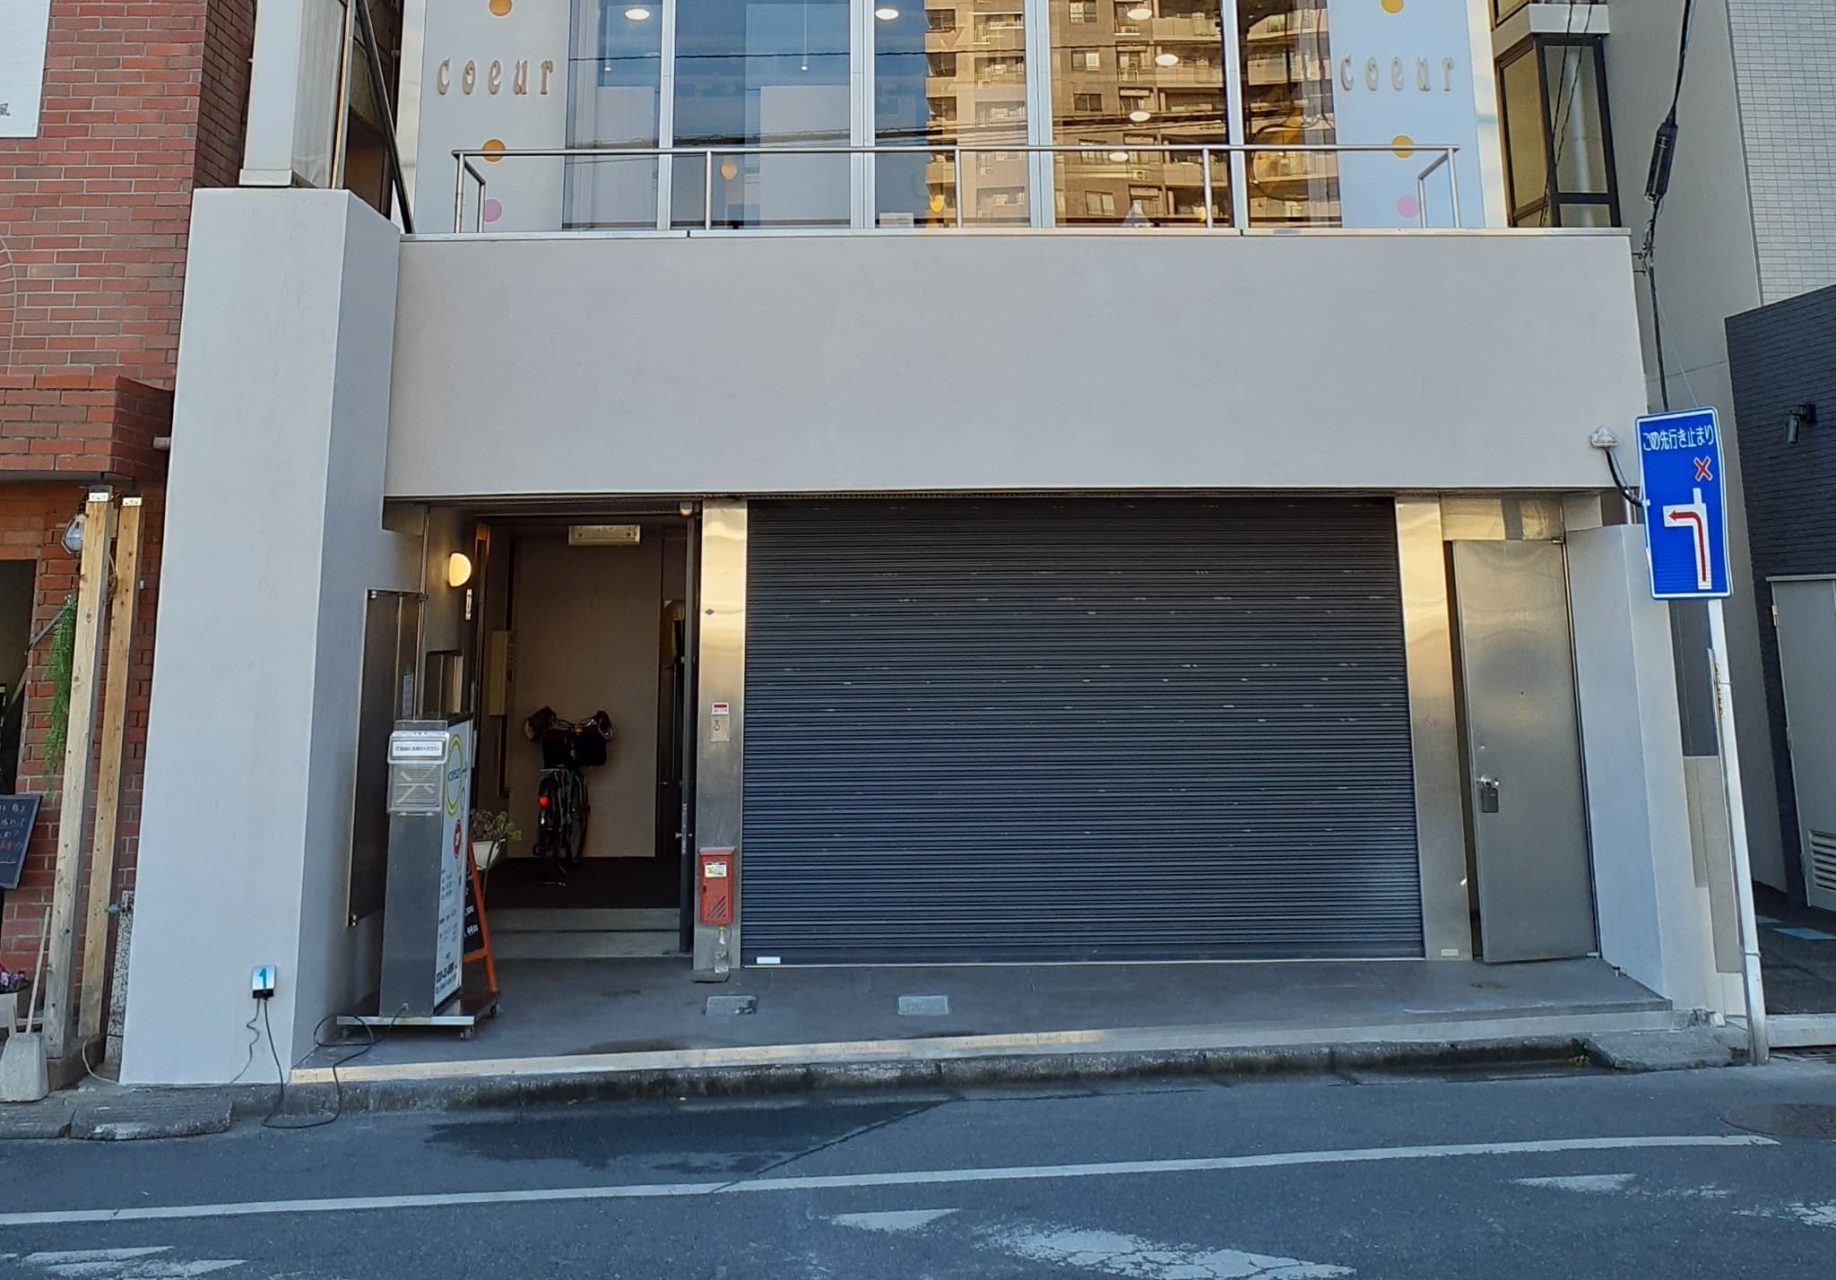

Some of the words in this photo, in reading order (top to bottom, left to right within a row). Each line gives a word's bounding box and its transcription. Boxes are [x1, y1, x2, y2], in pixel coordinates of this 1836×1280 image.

[436, 58, 554, 96] coeur
[1340, 54, 1455, 93] coeur
[1642, 424, 1715, 451] この先行き止まり
